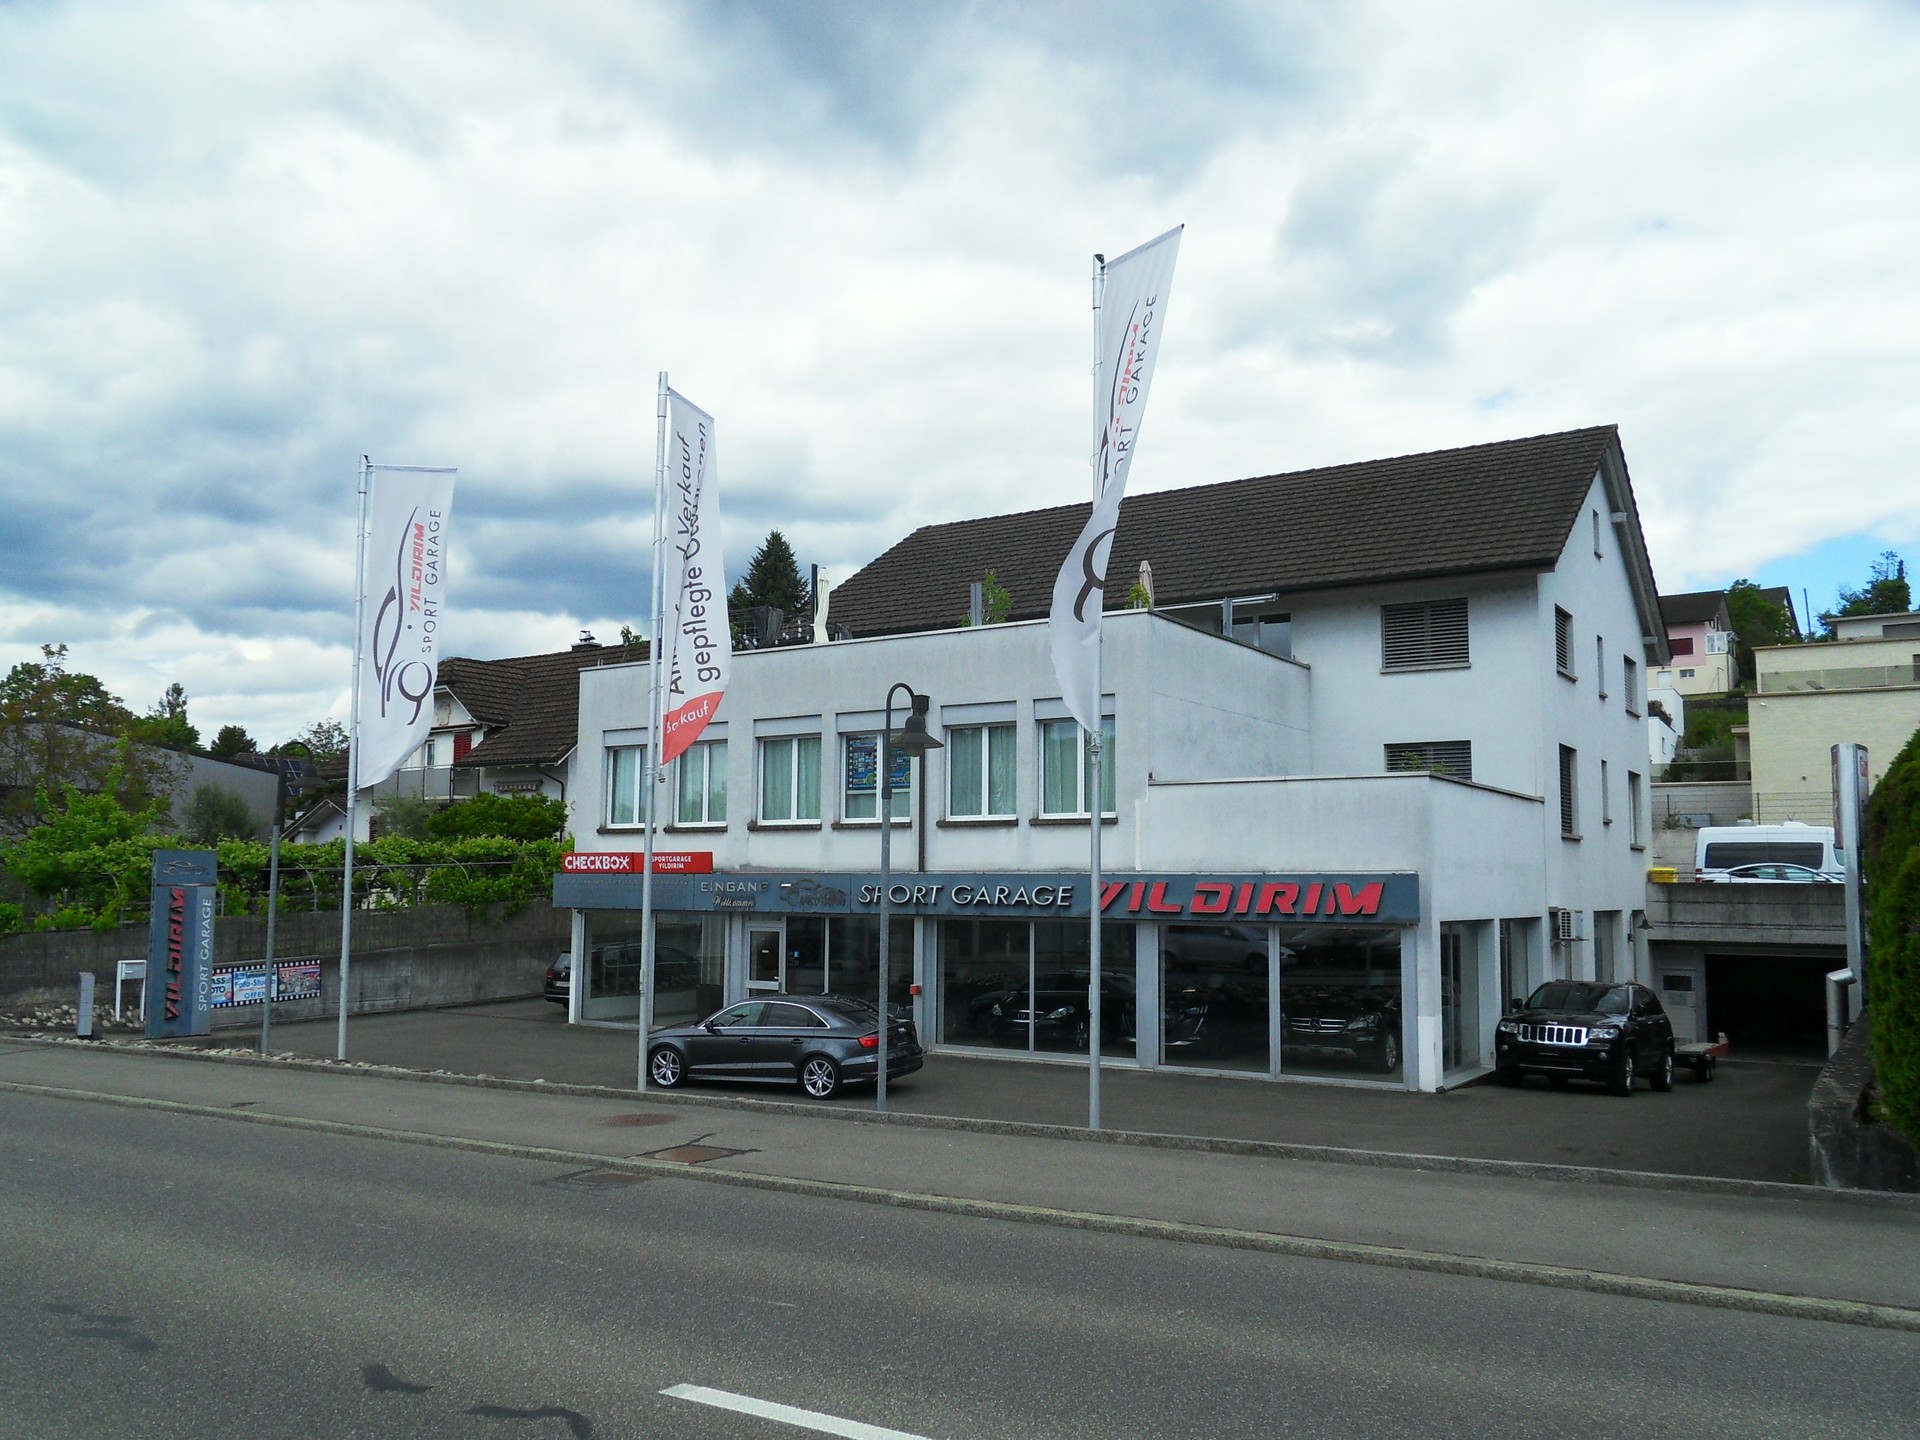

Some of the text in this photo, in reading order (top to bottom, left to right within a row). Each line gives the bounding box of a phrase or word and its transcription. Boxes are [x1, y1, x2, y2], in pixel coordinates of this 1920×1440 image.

[677, 431, 692, 535] Verkauf
[409, 522, 425, 613] YILDIRIM
[421, 509, 442, 653] SPORT GARAGE
[683, 566, 721, 683] gepflegte
[666, 699, 709, 735] Bakauf
[564, 855, 630, 870] CHECKBOX
[651, 855, 692, 863] SPORTGARAGE
[701, 881, 768, 893] EINGANG
[951, 885, 1073, 906] GARAGE
[164, 887, 187, 1021] YILDIRIM
[198, 898, 212, 1011] SPORT GARAGE
[211, 977, 226, 985] ASS
[211, 986, 226, 995] OTO
